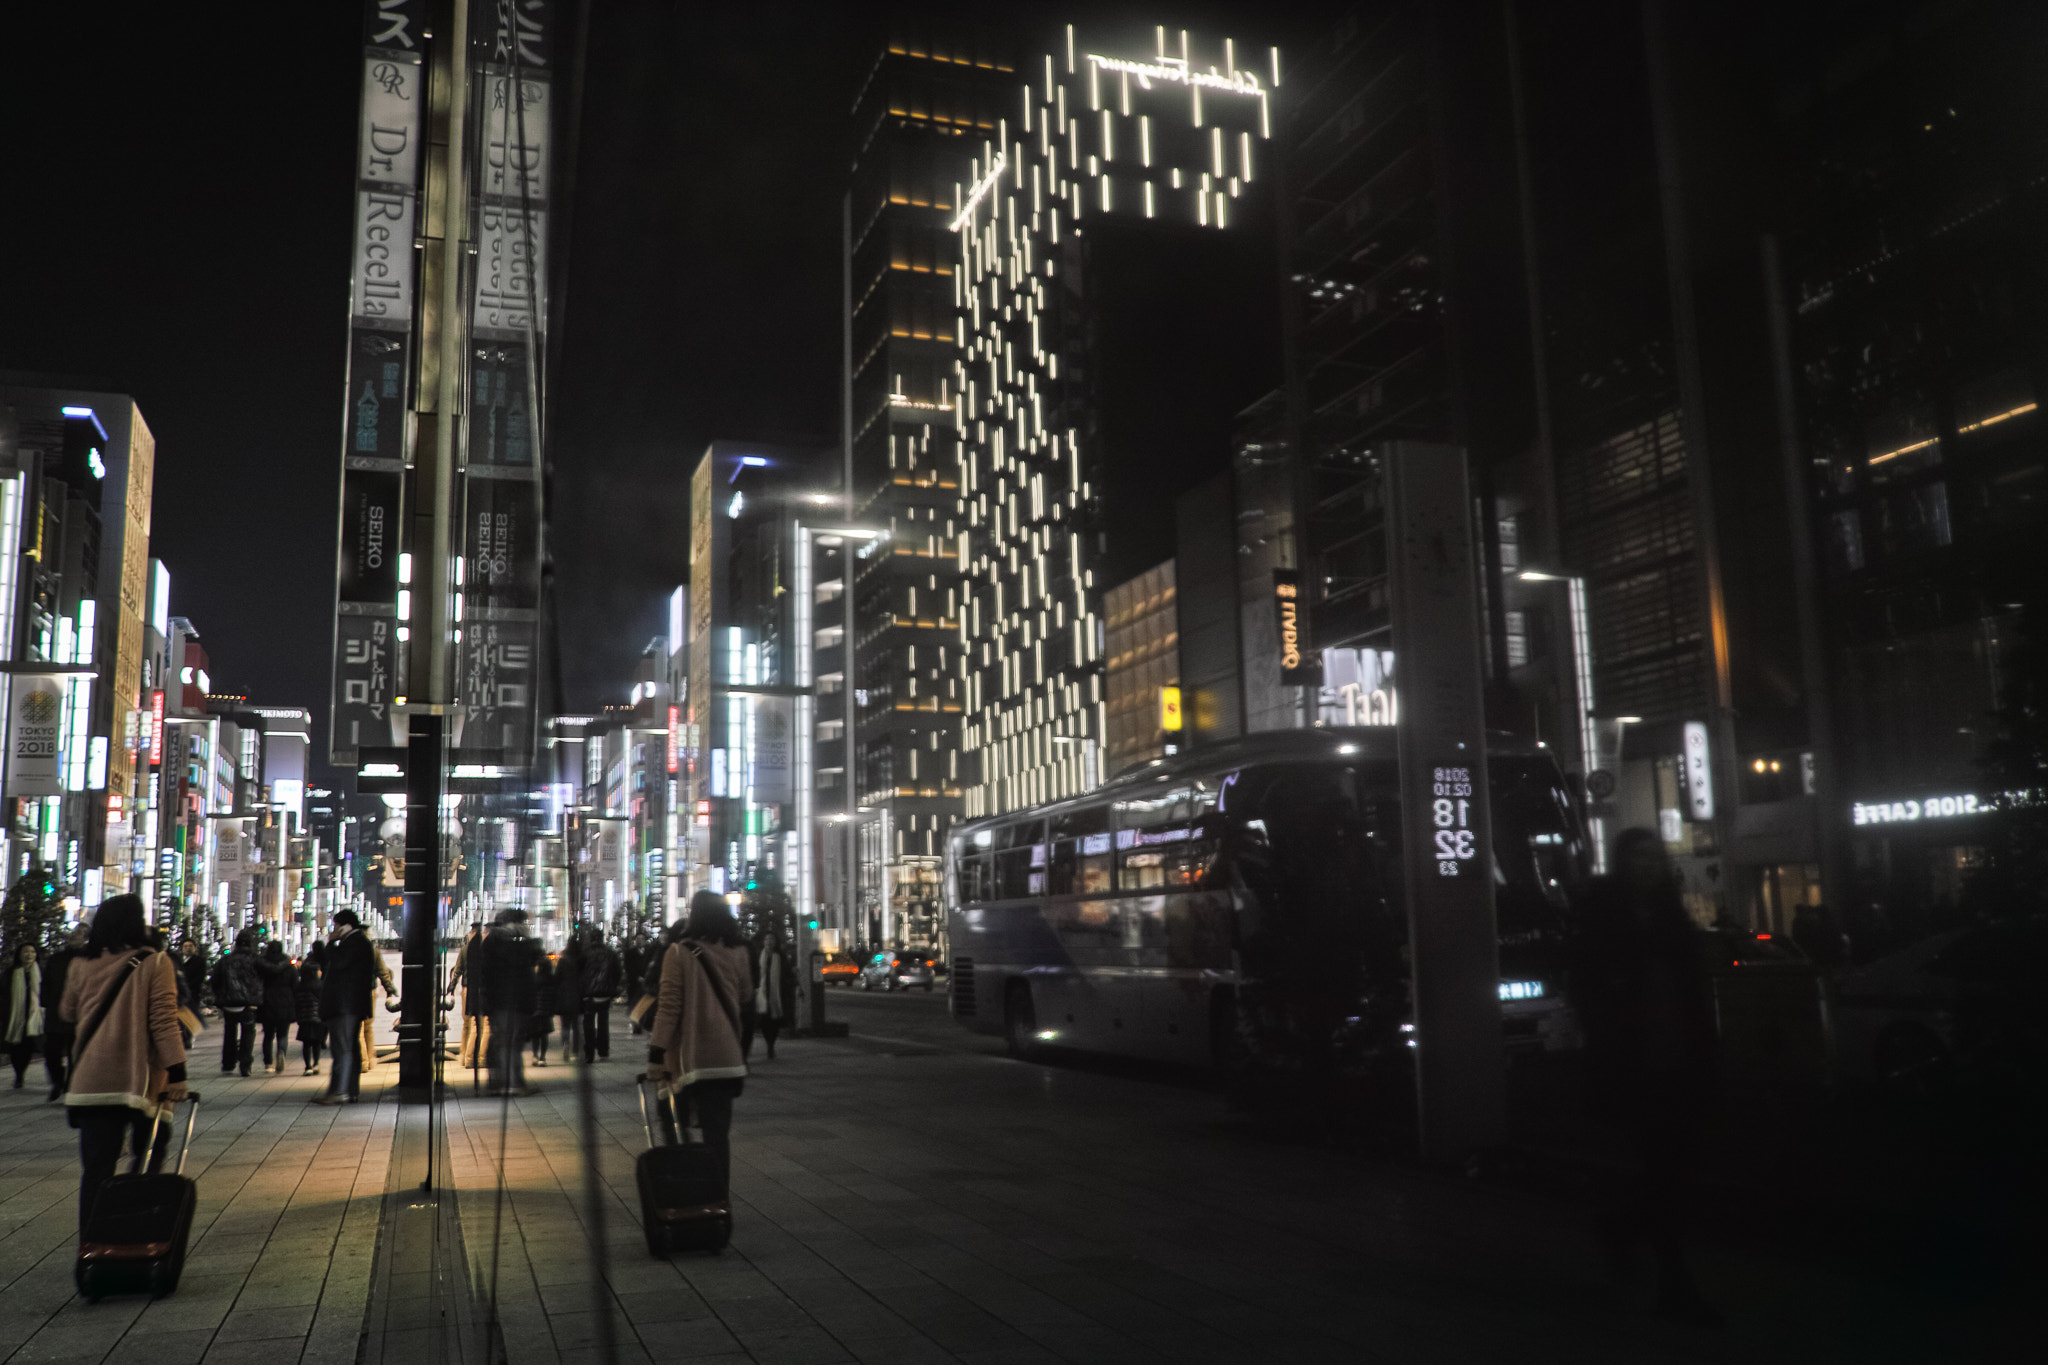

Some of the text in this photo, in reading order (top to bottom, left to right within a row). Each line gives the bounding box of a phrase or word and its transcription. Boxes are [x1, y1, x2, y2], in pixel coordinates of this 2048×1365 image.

[363, 123, 407, 316] Dr. Recella
[368, 505, 384, 569] SEIKO
[17, 741, 55, 753] 2018
[18, 727, 55, 735] TOKYO
